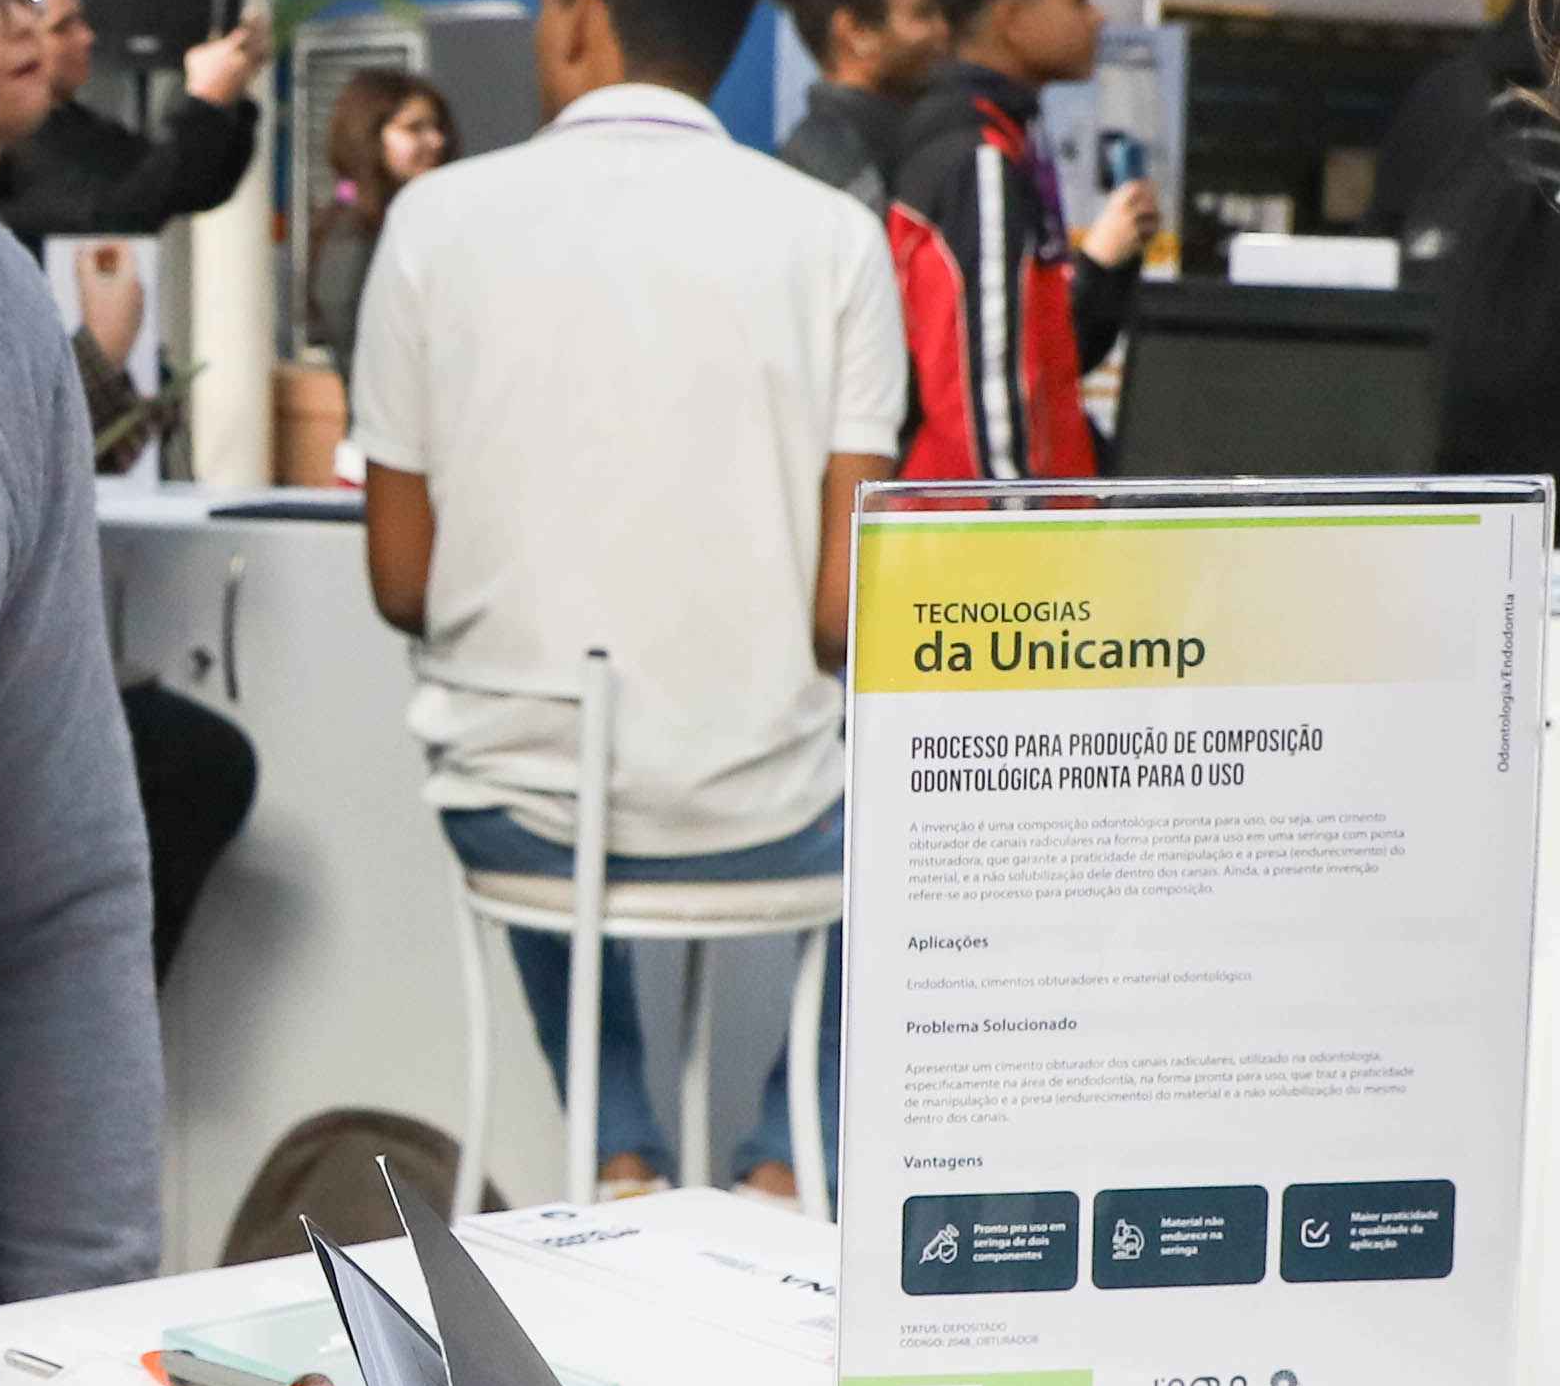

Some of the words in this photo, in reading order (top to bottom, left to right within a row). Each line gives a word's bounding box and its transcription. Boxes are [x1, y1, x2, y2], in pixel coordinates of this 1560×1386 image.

[914, 601, 1090, 624] TECNOLOGIAS
[914, 629, 971, 672] da
[990, 629, 1205, 678] Unicamp
[1497, 593, 1515, 773] Odontologia/Endodontia
[911, 734, 1008, 759] PROCESSO
[1015, 733, 1062, 757] PARA
[1069, 727, 1167, 759] PRODUÇÃO
[1174, 730, 1196, 754] DE
[1203, 724, 1322, 755] COMPOSIÇÃO
[911, 762, 1052, 793] ODONTOLÓGICA
[1059, 765, 1131, 789] PRONTA
[1137, 763, 1184, 787] PARA
[1191, 763, 1202, 786] O
[1208, 762, 1244, 786] USO
[907, 935, 988, 952] Aplicações
[906, 1019, 979, 1034] Problema
[983, 1016, 1077, 1032] Solucionado
[903, 1154, 983, 1171] Vantagens
[973, 1224, 1008, 1235] Pronto
[1009, 1225, 1027, 1237] pra
[1029, 1224, 1047, 1233] uso
[1048, 1222, 1066, 1232] em
[1160, 1215, 1203, 1228] Material
[1204, 1215, 1224, 1226] não
[973, 1239, 1011, 1251] seringa
[1012, 1235, 1026, 1247] de
[1027, 1234, 1049, 1246] dois
[1160, 1230, 1208, 1242] endurece
[972, 1250, 1042, 1263] componentes
[1160, 1244, 1198, 1258] seringa
